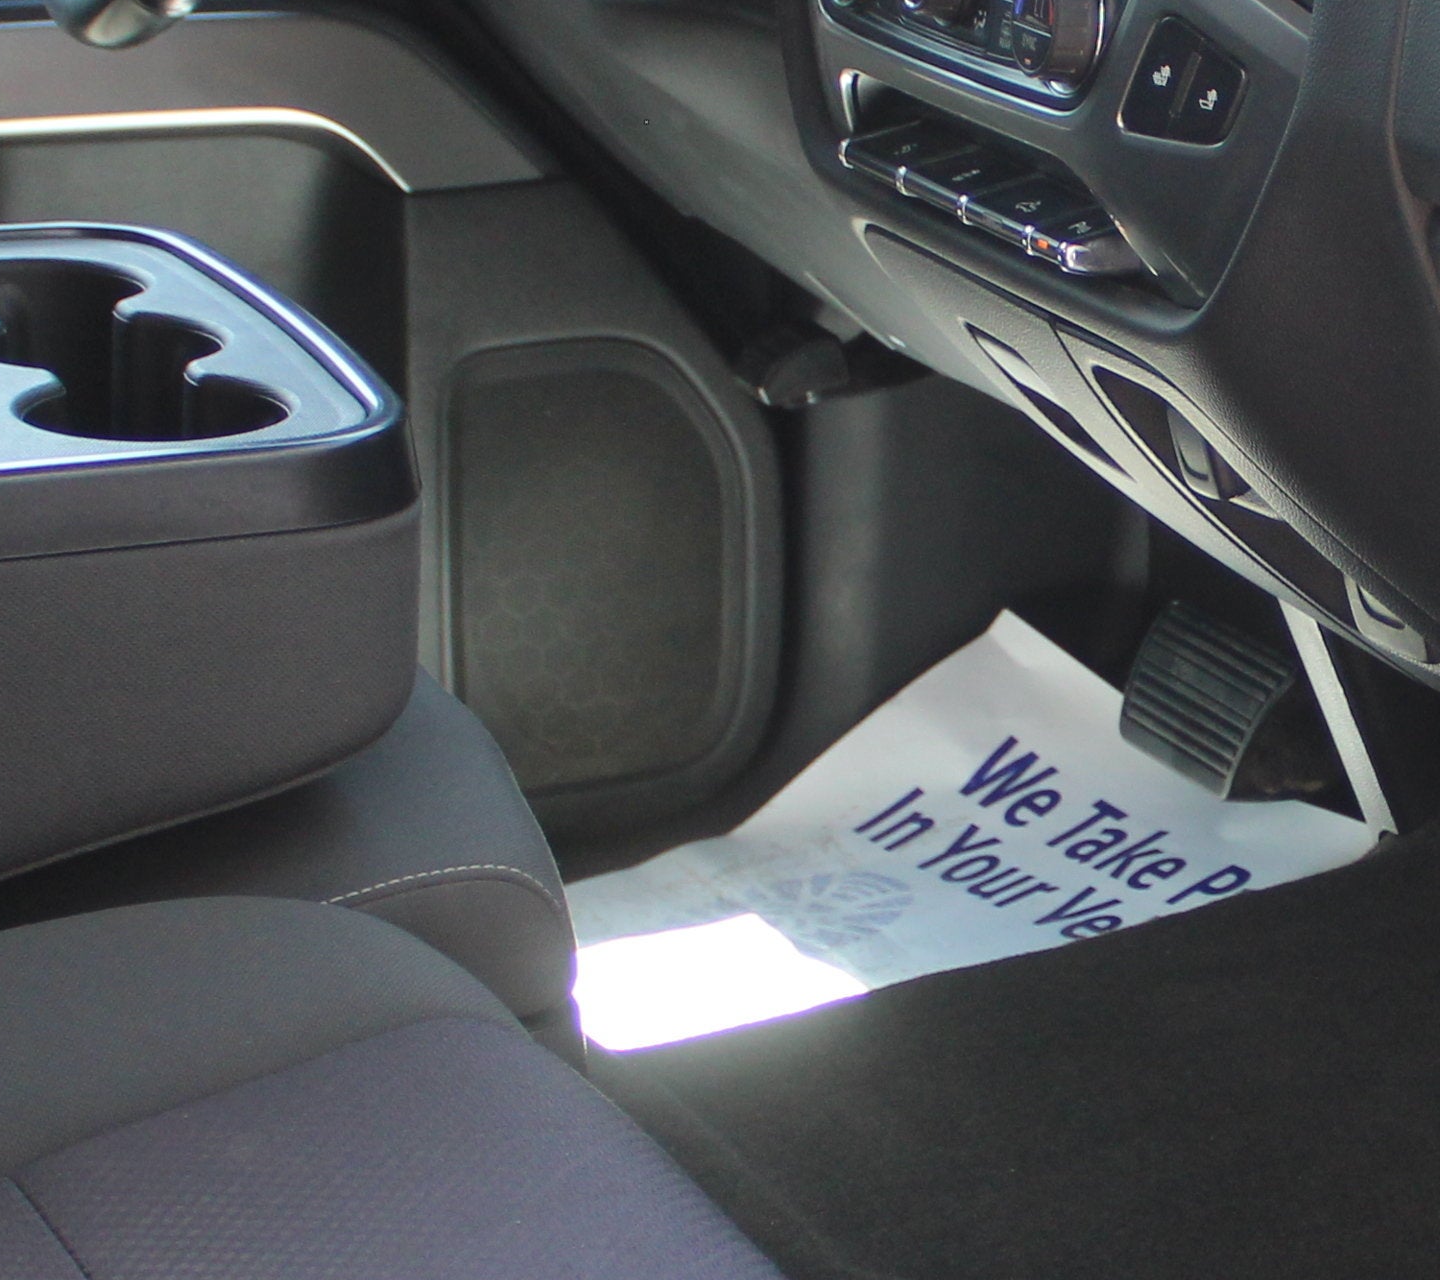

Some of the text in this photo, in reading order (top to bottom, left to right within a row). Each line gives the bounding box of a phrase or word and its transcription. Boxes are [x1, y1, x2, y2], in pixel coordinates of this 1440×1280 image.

[853, 787, 935, 851] In
[916, 823, 1059, 908] Your
[959, 735, 1062, 827] We
[1046, 799, 1188, 890] Take
